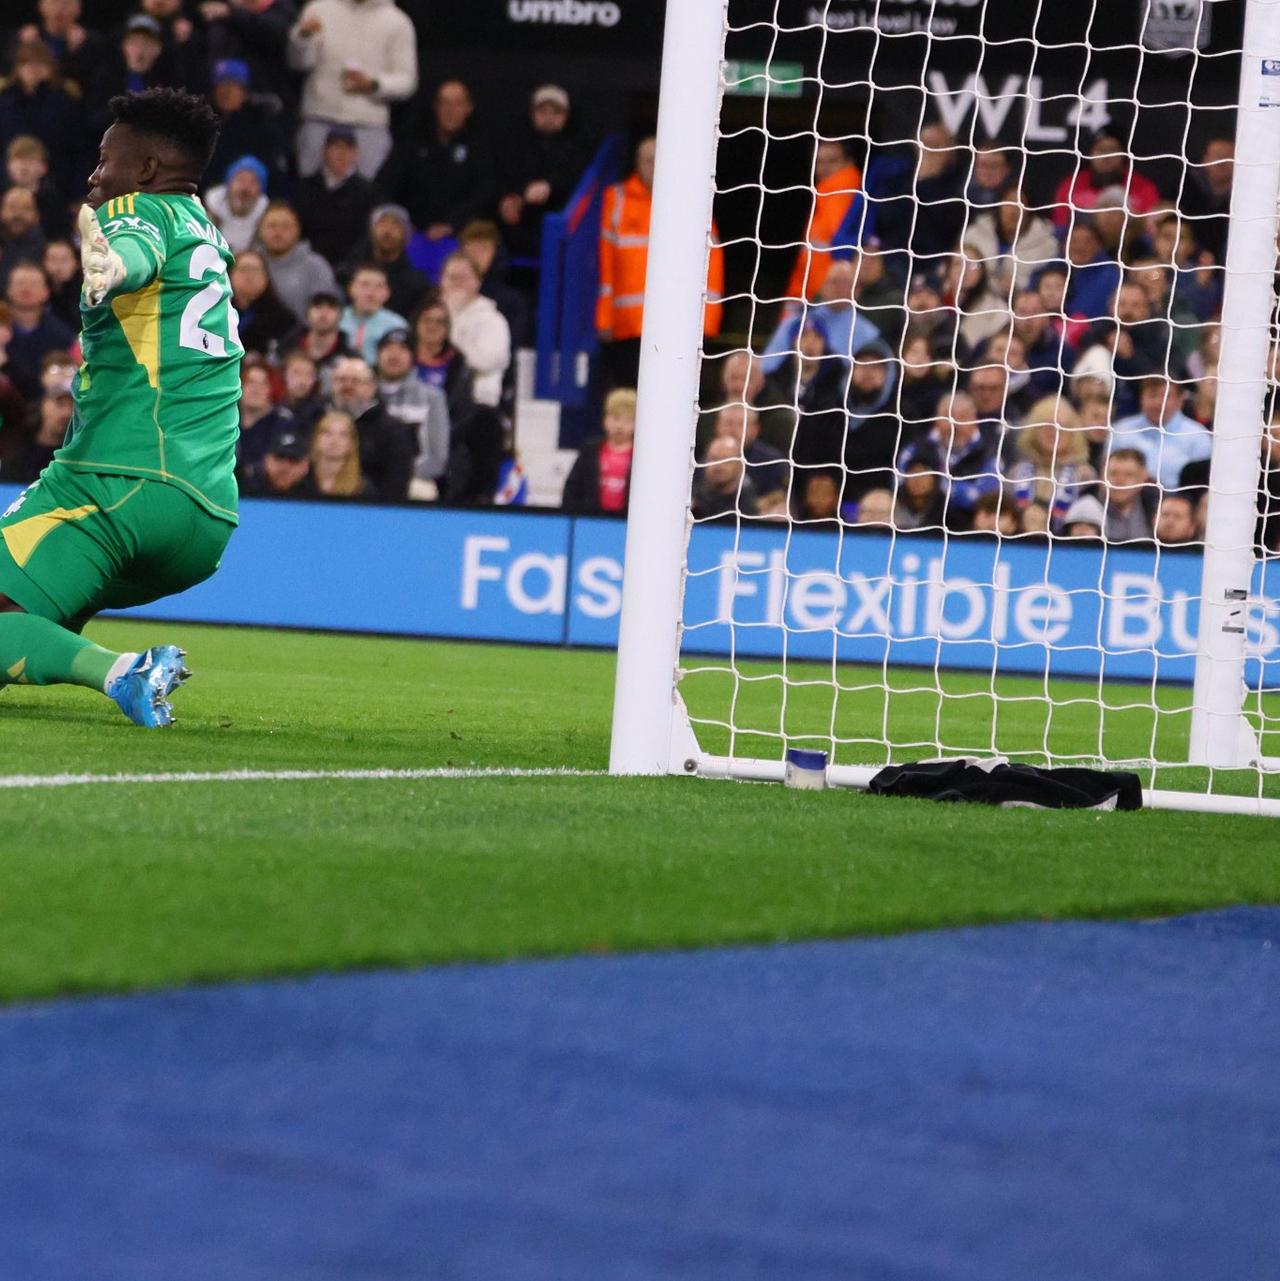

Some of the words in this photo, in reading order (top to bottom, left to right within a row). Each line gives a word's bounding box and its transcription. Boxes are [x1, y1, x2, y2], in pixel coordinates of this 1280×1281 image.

[928, 70, 1112, 142] WL4
[460, 534, 626, 620] Fas
[717, 549, 1074, 645] Flexible
